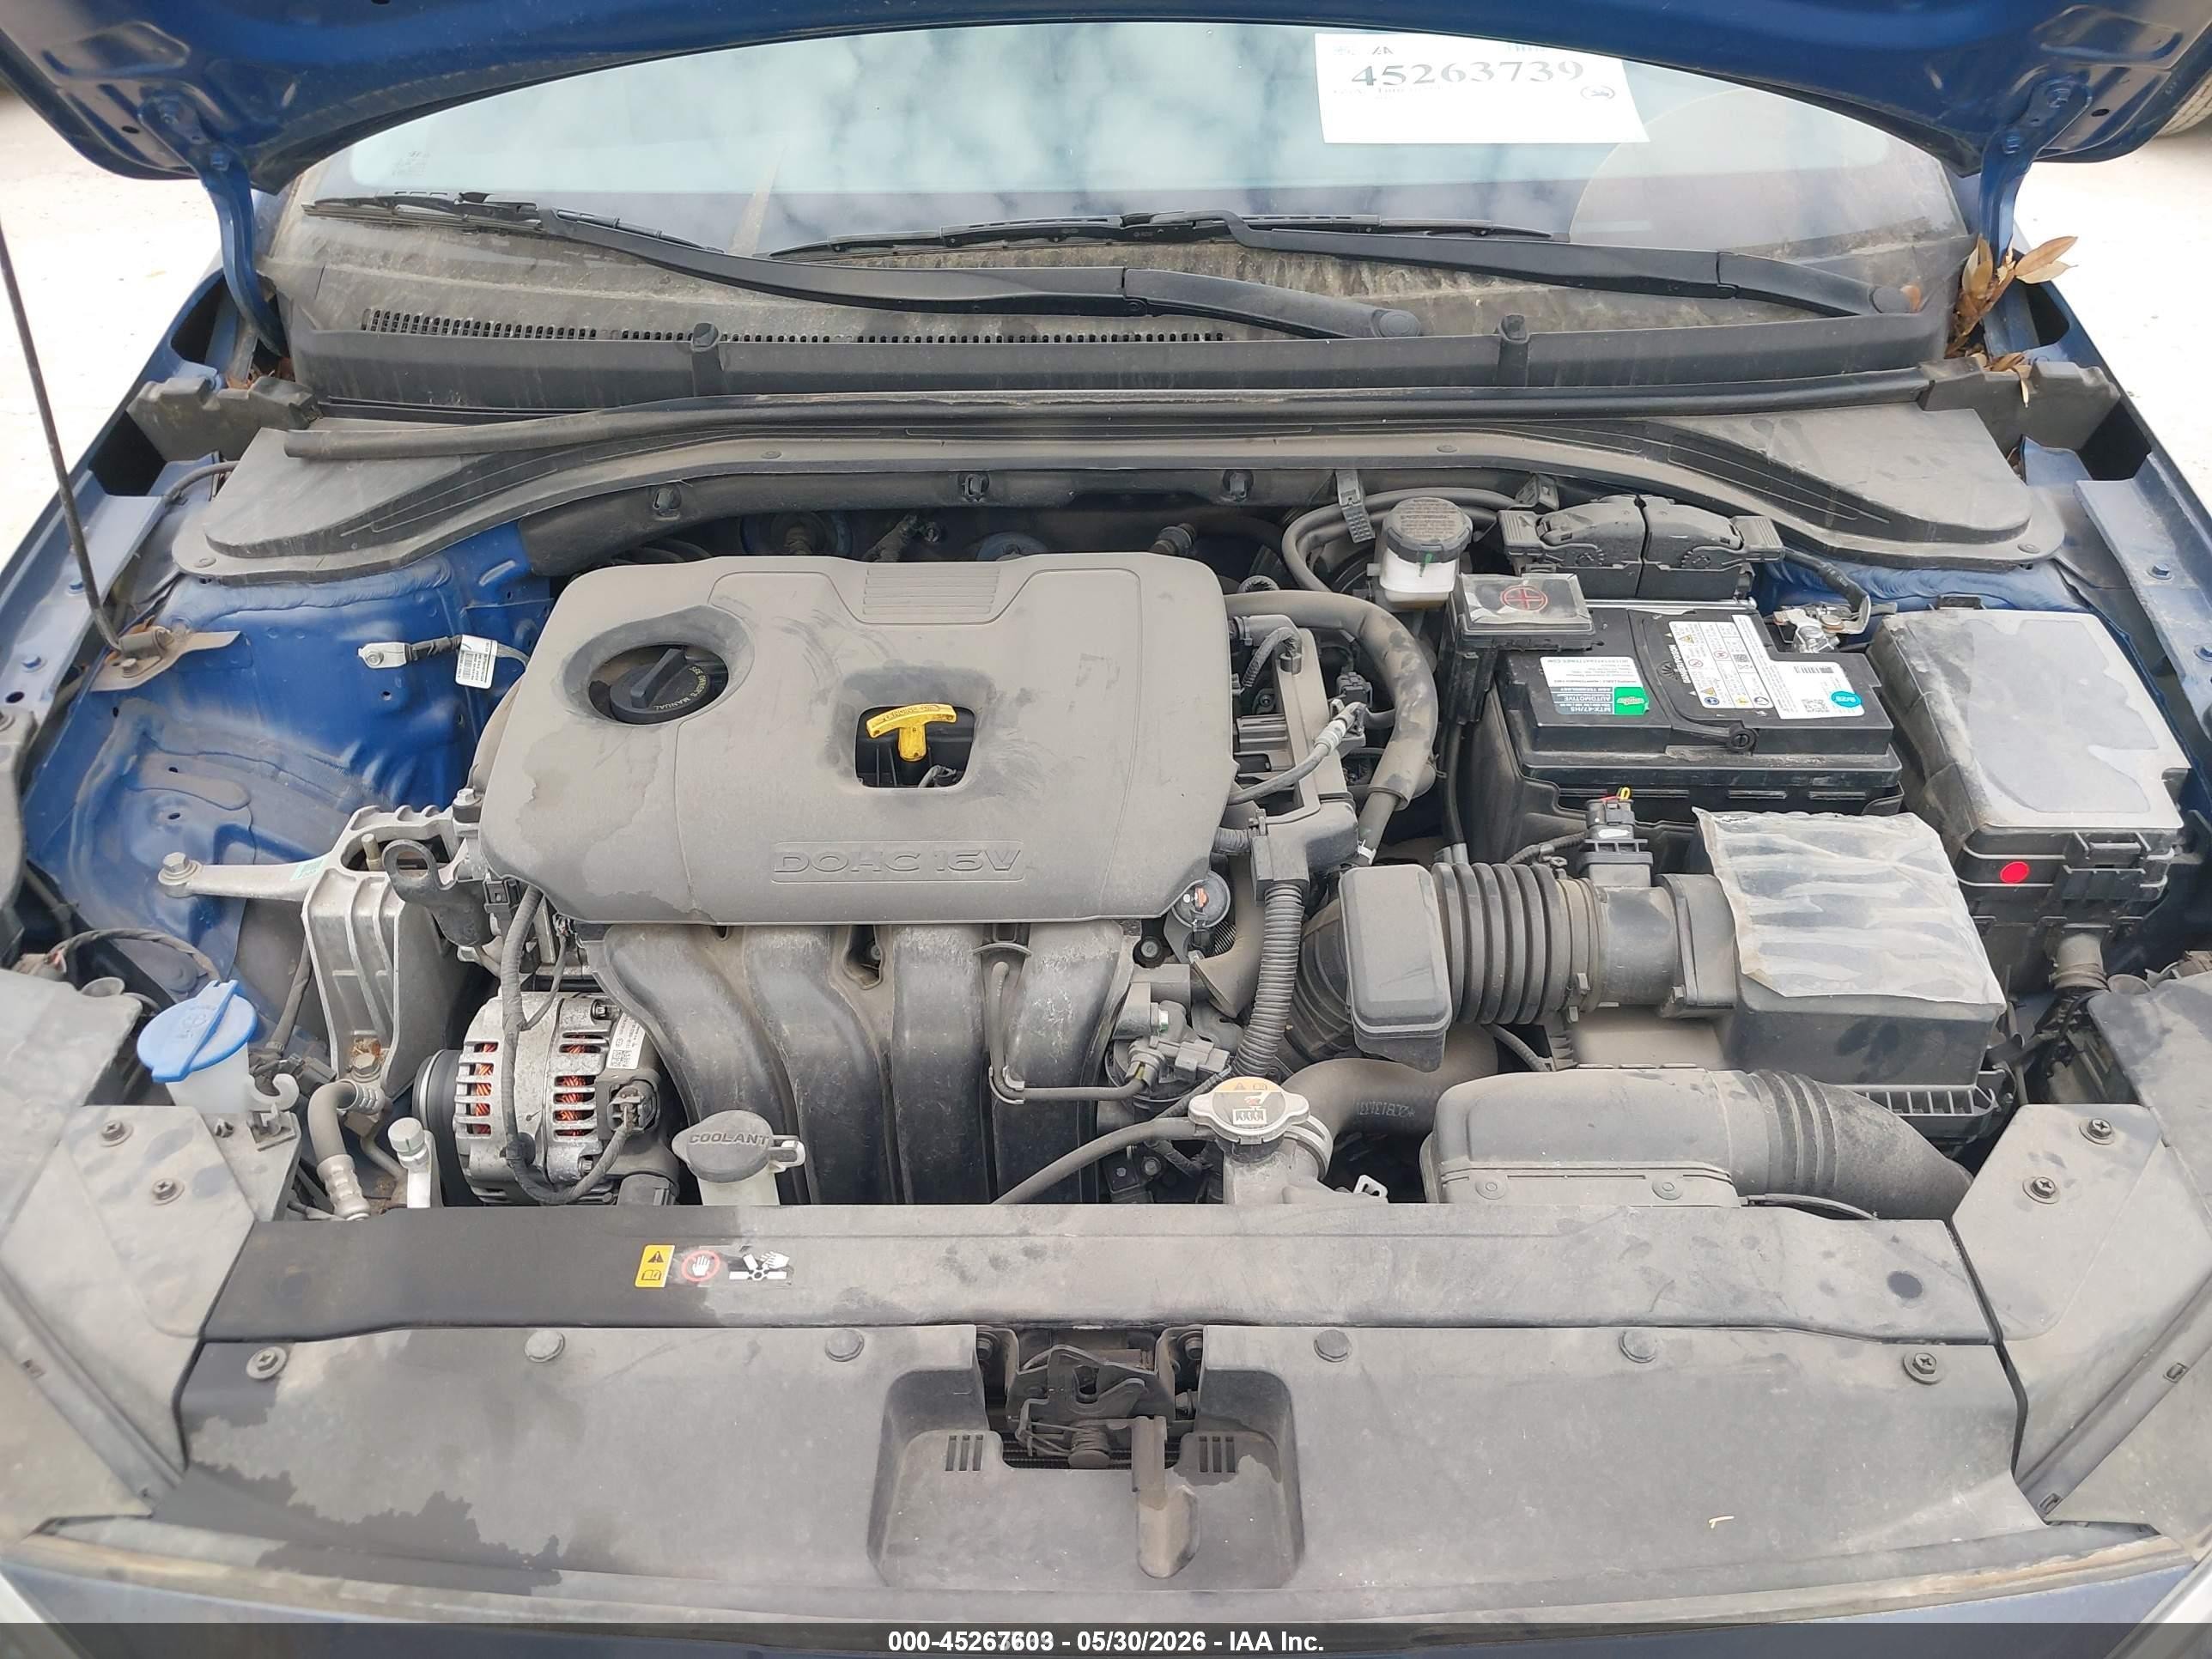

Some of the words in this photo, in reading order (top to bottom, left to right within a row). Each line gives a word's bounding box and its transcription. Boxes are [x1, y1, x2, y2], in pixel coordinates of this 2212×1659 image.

[1352, 60, 1583, 86] 45263739
[653, 696, 691, 711] MANUAL
[774, 850, 921, 873] DOHC
[933, 848, 1022, 873] 16V
[689, 1133, 770, 1146] COOLANT
